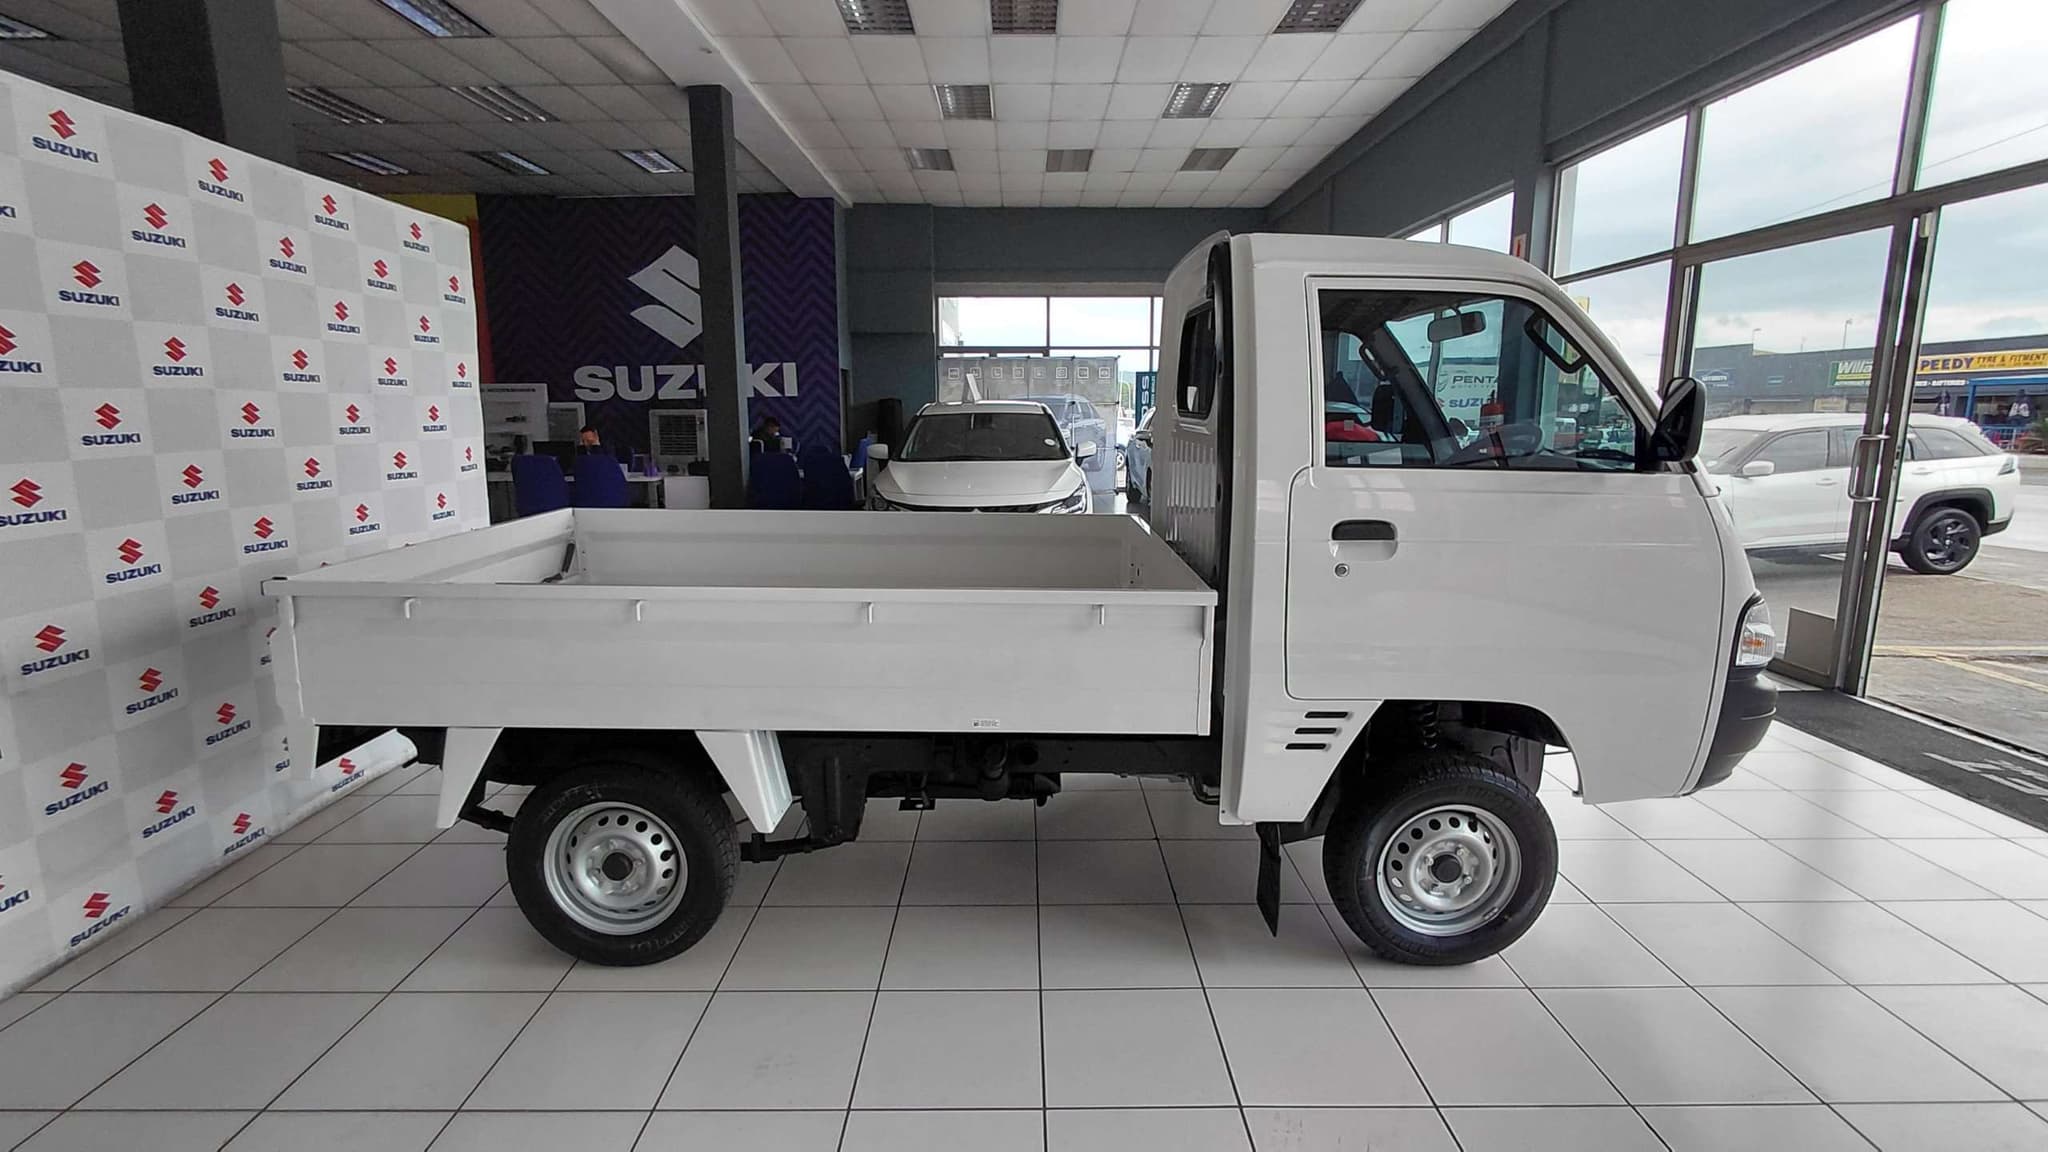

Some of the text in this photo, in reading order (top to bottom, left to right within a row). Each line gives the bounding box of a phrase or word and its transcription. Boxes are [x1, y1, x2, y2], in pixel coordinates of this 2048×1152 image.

[32, 136, 98, 163] SUZUKI
[198, 179, 244, 203] SUZUKI
[315, 214, 349, 231] SUZUKI
[131, 230, 185, 249] SUZUKI
[269, 258, 307, 275] SUZUKI
[367, 278, 397, 292] SUZUKI
[58, 289, 120, 307] SUZUKI
[216, 306, 259, 322] SUZUKI
[327, 322, 360, 335] SUZUKI
[0, 360, 42, 373] ZUKI
[153, 365, 203, 377] SUZUKI
[1920, 357, 1973, 371] PEEDY
[283, 372, 320, 383] SUZUKI
[377, 377, 407, 387] SUZUKI
[574, 362, 798, 401] SUZKI
[82, 432, 141, 446] SUZUKI
[231, 428, 275, 438] SUZUKI
[339, 426, 370, 435] SUZUKI
[297, 479, 333, 491] SUZUKI
[172, 489, 219, 505] SUZUKI
[0, 510, 67, 528] SUZUKI
[349, 522, 380, 535] SUZUKI
[243, 539, 288, 554] SUZUKI
[106, 563, 161, 584] SUZUKI
[190, 607, 236, 628] SUZUKI
[21, 648, 90, 676] SUZUKI
[126, 687, 178, 714] SUZUKI
[206, 719, 251, 746] SUZUKI
[45, 780, 108, 816] SUZUKI
[141, 805, 195, 839] SUZUKI
[223, 826, 265, 856] SUZUKI
[70, 905, 130, 947] SUZUKI
